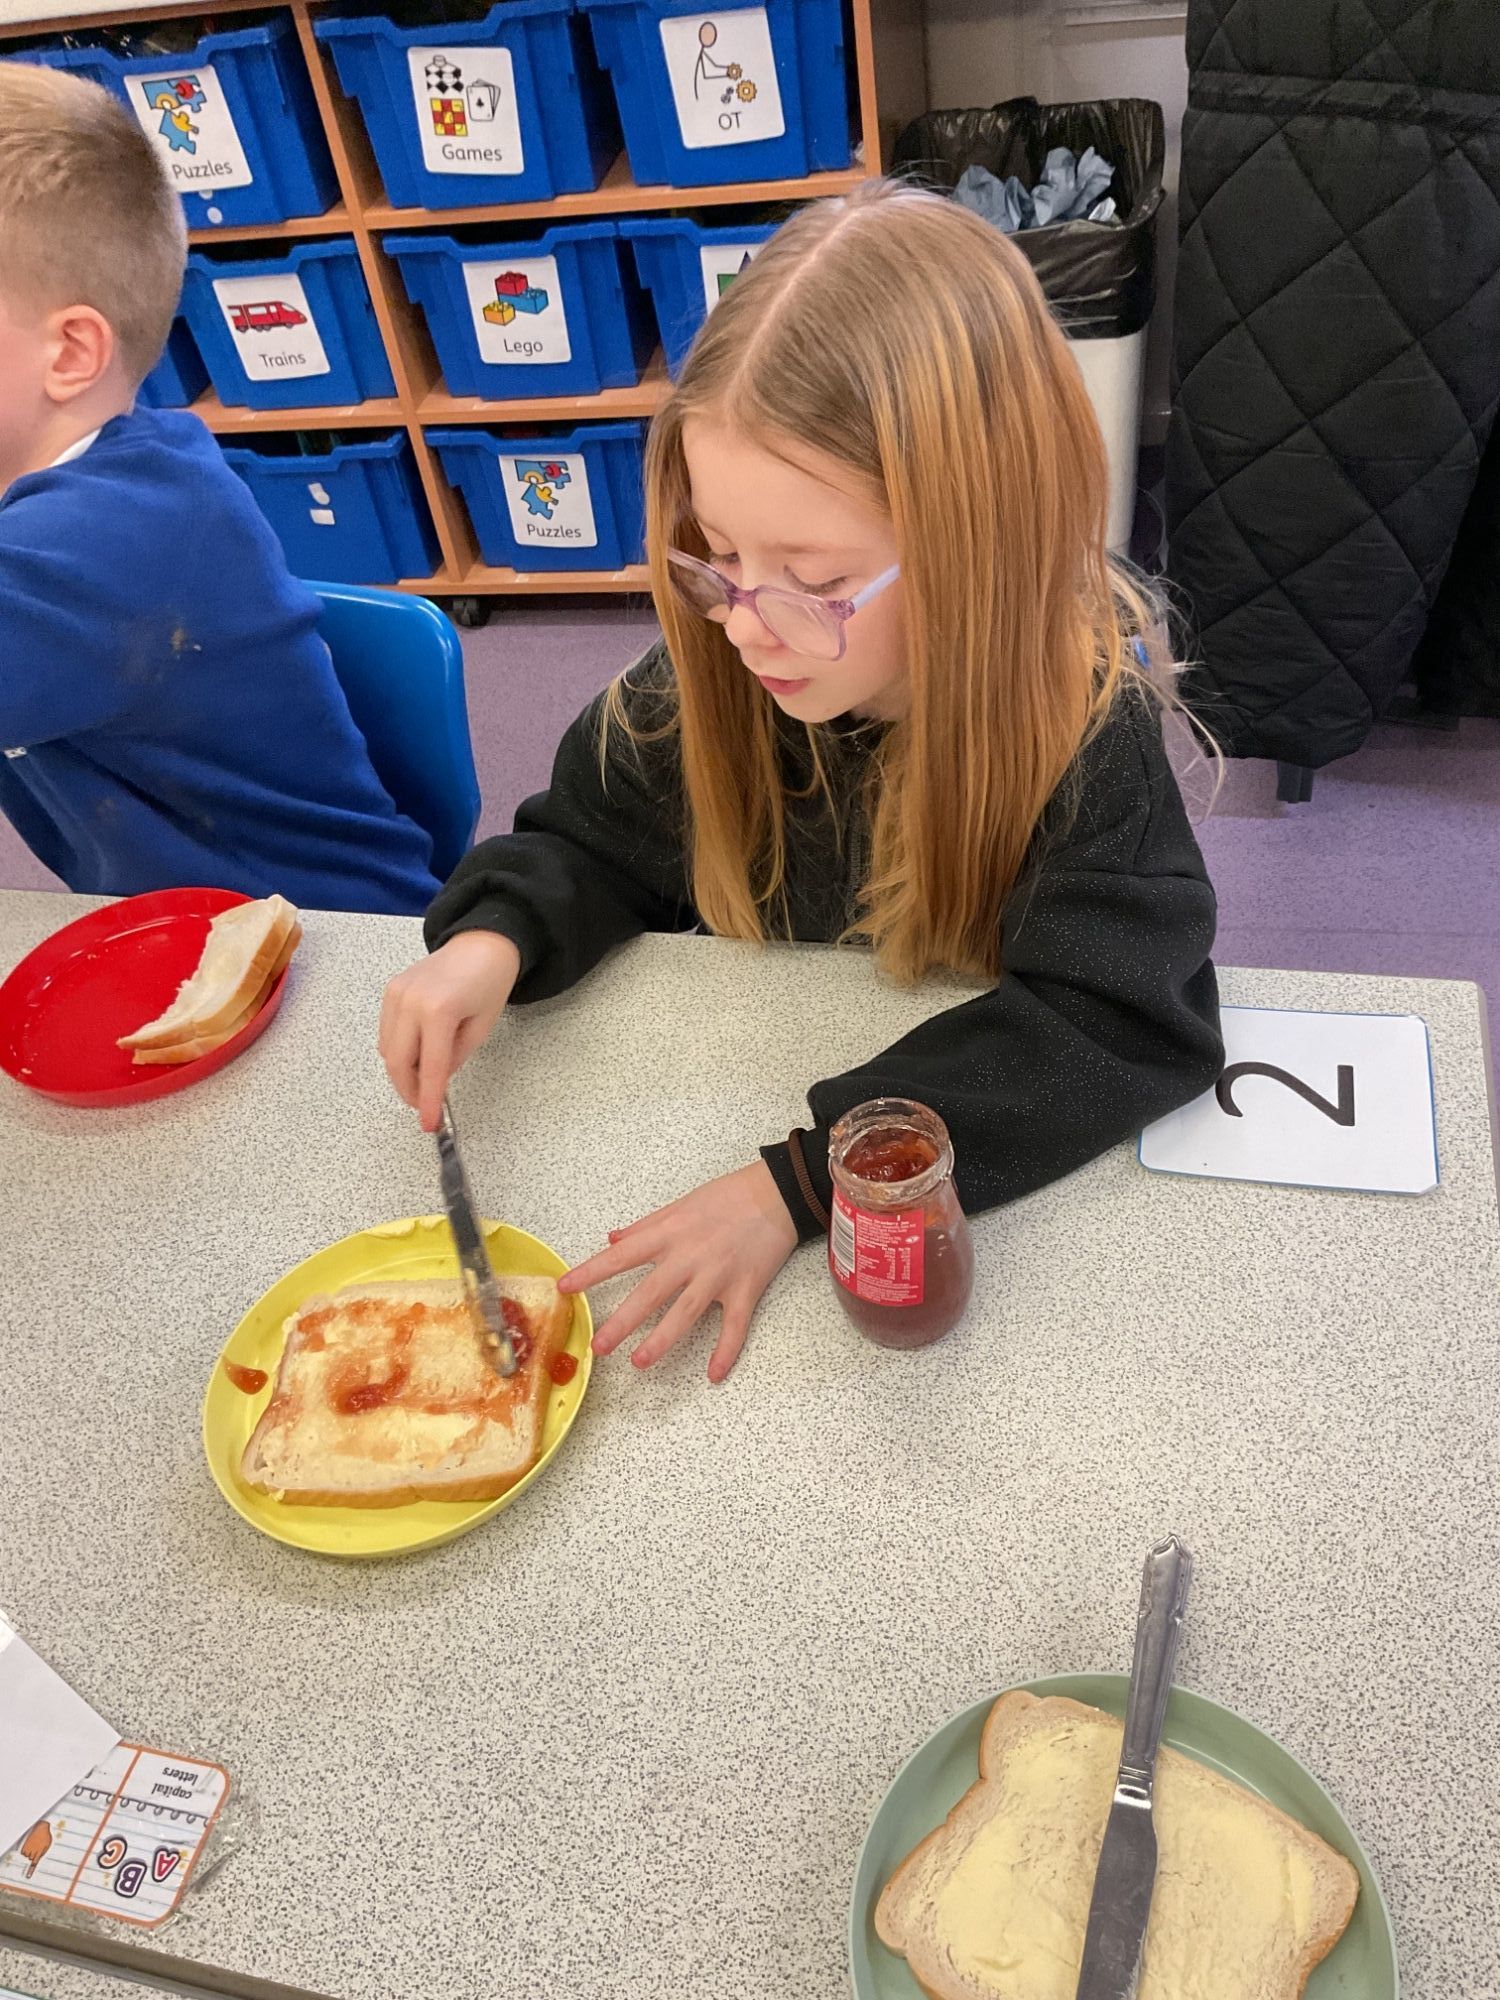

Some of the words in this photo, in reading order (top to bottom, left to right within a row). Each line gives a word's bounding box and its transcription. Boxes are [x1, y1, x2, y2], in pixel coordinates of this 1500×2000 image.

[718, 111, 742, 130] OT
[442, 143, 503, 162] Games
[171, 160, 233, 179] Puzzles
[503, 338, 543, 357] Lego
[259, 352, 306, 368] Trains
[526, 523, 582, 538] Puzzles
[1215, 1061, 1355, 1126] 2
[162, 1767, 199, 1786] letters
[151, 1783, 193, 1800] capital
